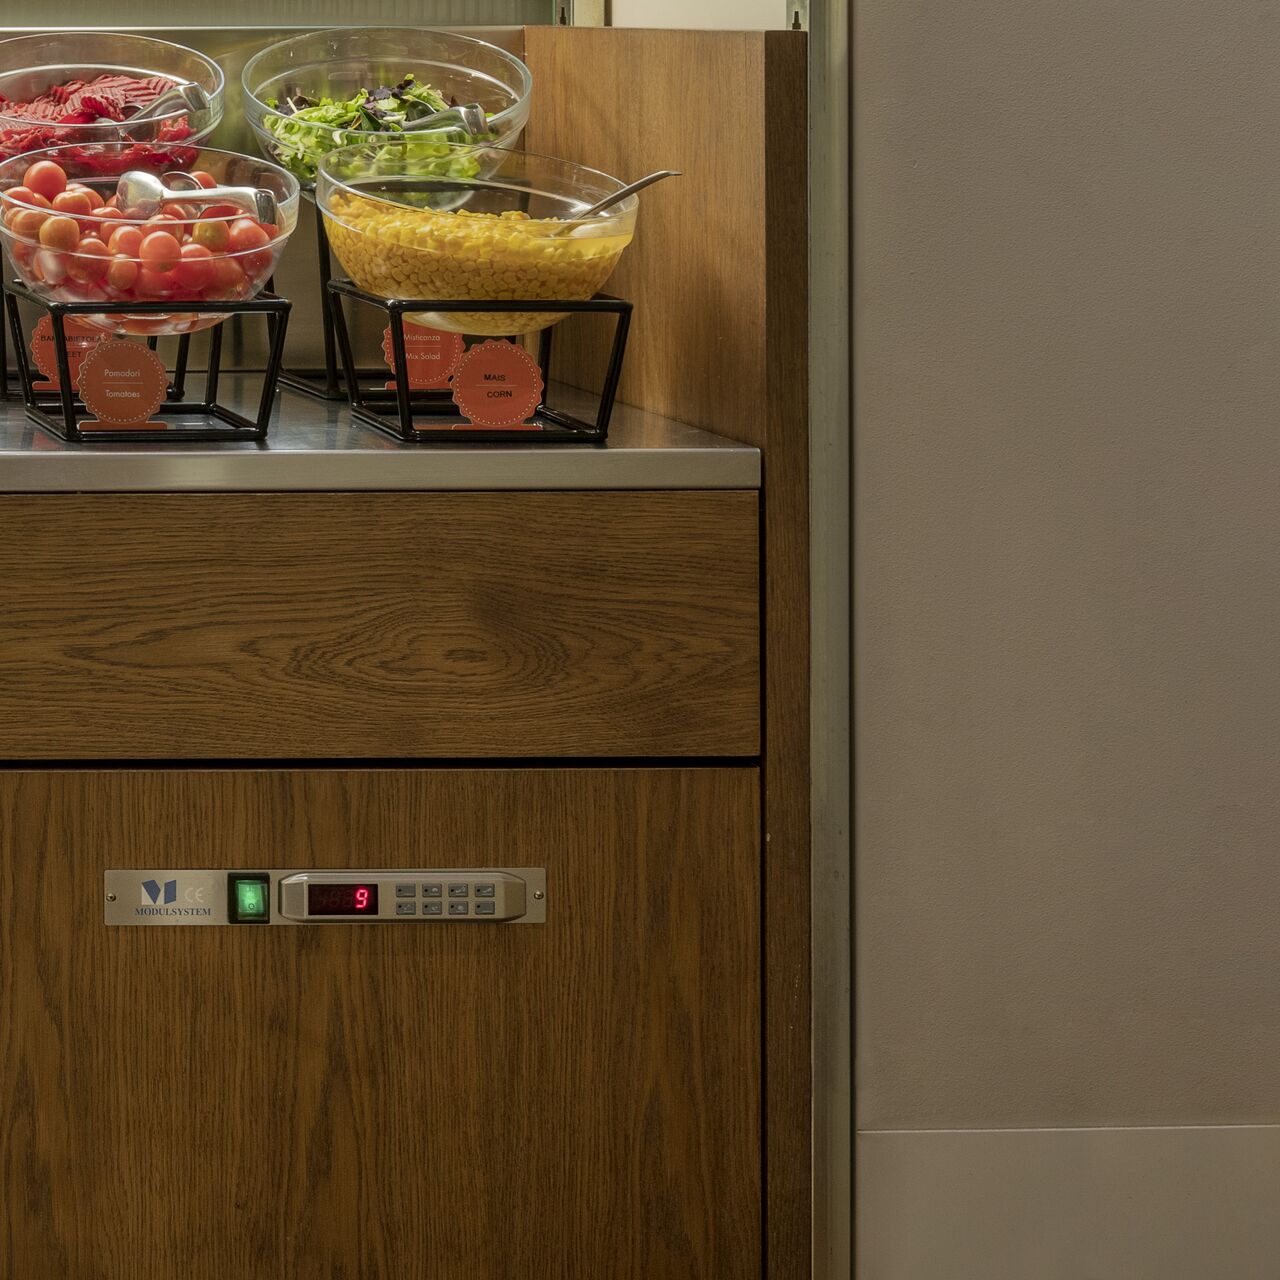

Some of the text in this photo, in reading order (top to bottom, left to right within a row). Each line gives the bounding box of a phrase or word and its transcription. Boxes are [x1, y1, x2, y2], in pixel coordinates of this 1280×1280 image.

[404, 333, 441, 341] Misticanza
[405, 352, 441, 360] Mix Salad
[104, 369, 140, 377] Pomodori
[483, 373, 506, 382] MAIS
[105, 390, 140, 398] Tomatoes
[486, 390, 512, 399] CORN
[355, 888, 369, 909] 9
[134, 907, 211, 916] MODULSYSTEM
